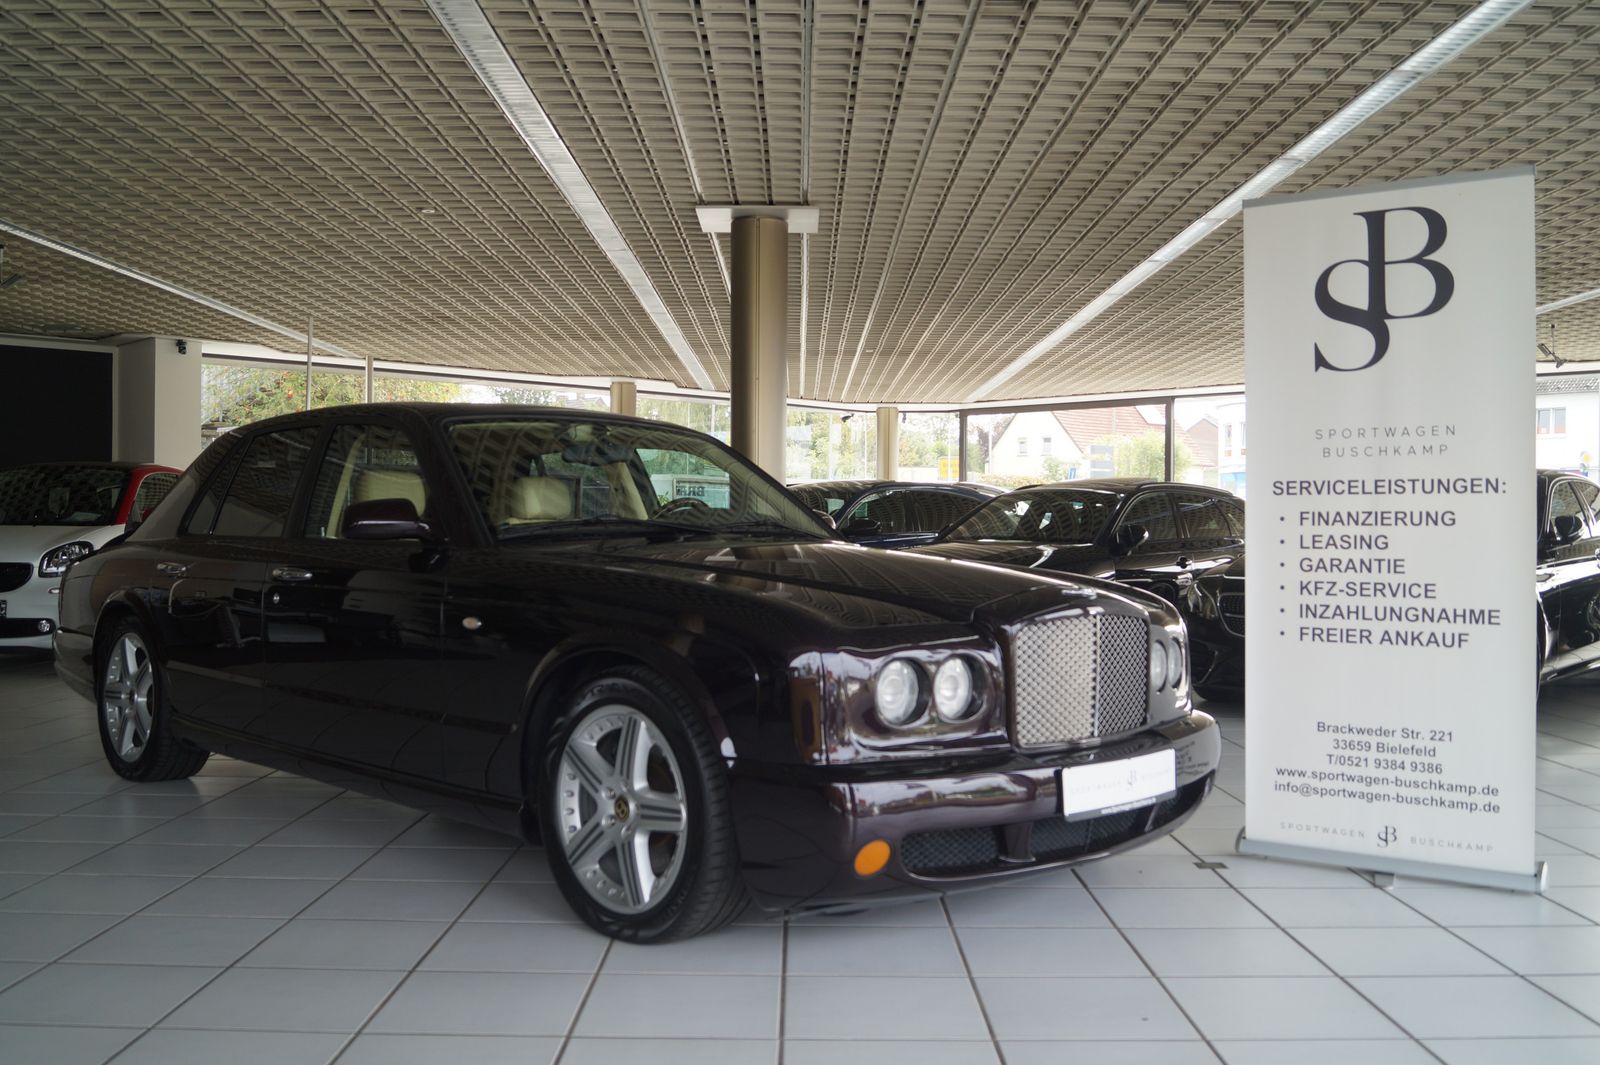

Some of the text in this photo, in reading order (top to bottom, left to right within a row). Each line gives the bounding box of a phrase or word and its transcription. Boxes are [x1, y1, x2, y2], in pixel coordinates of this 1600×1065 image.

[1315, 424, 1457, 440] SPORTWAGEN
[1322, 444, 1449, 458] BUSCHKAMP
[1272, 478, 1508, 496] SERVICELEISTUNGEN:
[1299, 510, 1457, 527] FINANZIERUNG
[1299, 534, 1390, 550] LEASING
[1299, 557, 1406, 574] GARANTIE
[1299, 580, 1437, 599] KFZ-SERVICE
[1299, 603, 1501, 626] INZAHLUNGNAHME
[1299, 626, 1470, 649] FREIER ANKAUF
[1316, 721, 1453, 743] Brackweder Str. 221
[1332, 738, 1437, 758] 33659 Bielefeld
[1326, 753, 1443, 775] T/0521 9384 9386
[1275, 767, 1500, 797] www.sportwagen-buschkamp.de
[1274, 780, 1501, 814] info@sportwagen-buschkamp.de
[1279, 821, 1367, 839] SPORTWAGEN
[1410, 835, 1494, 852] BUSCHKAMP
